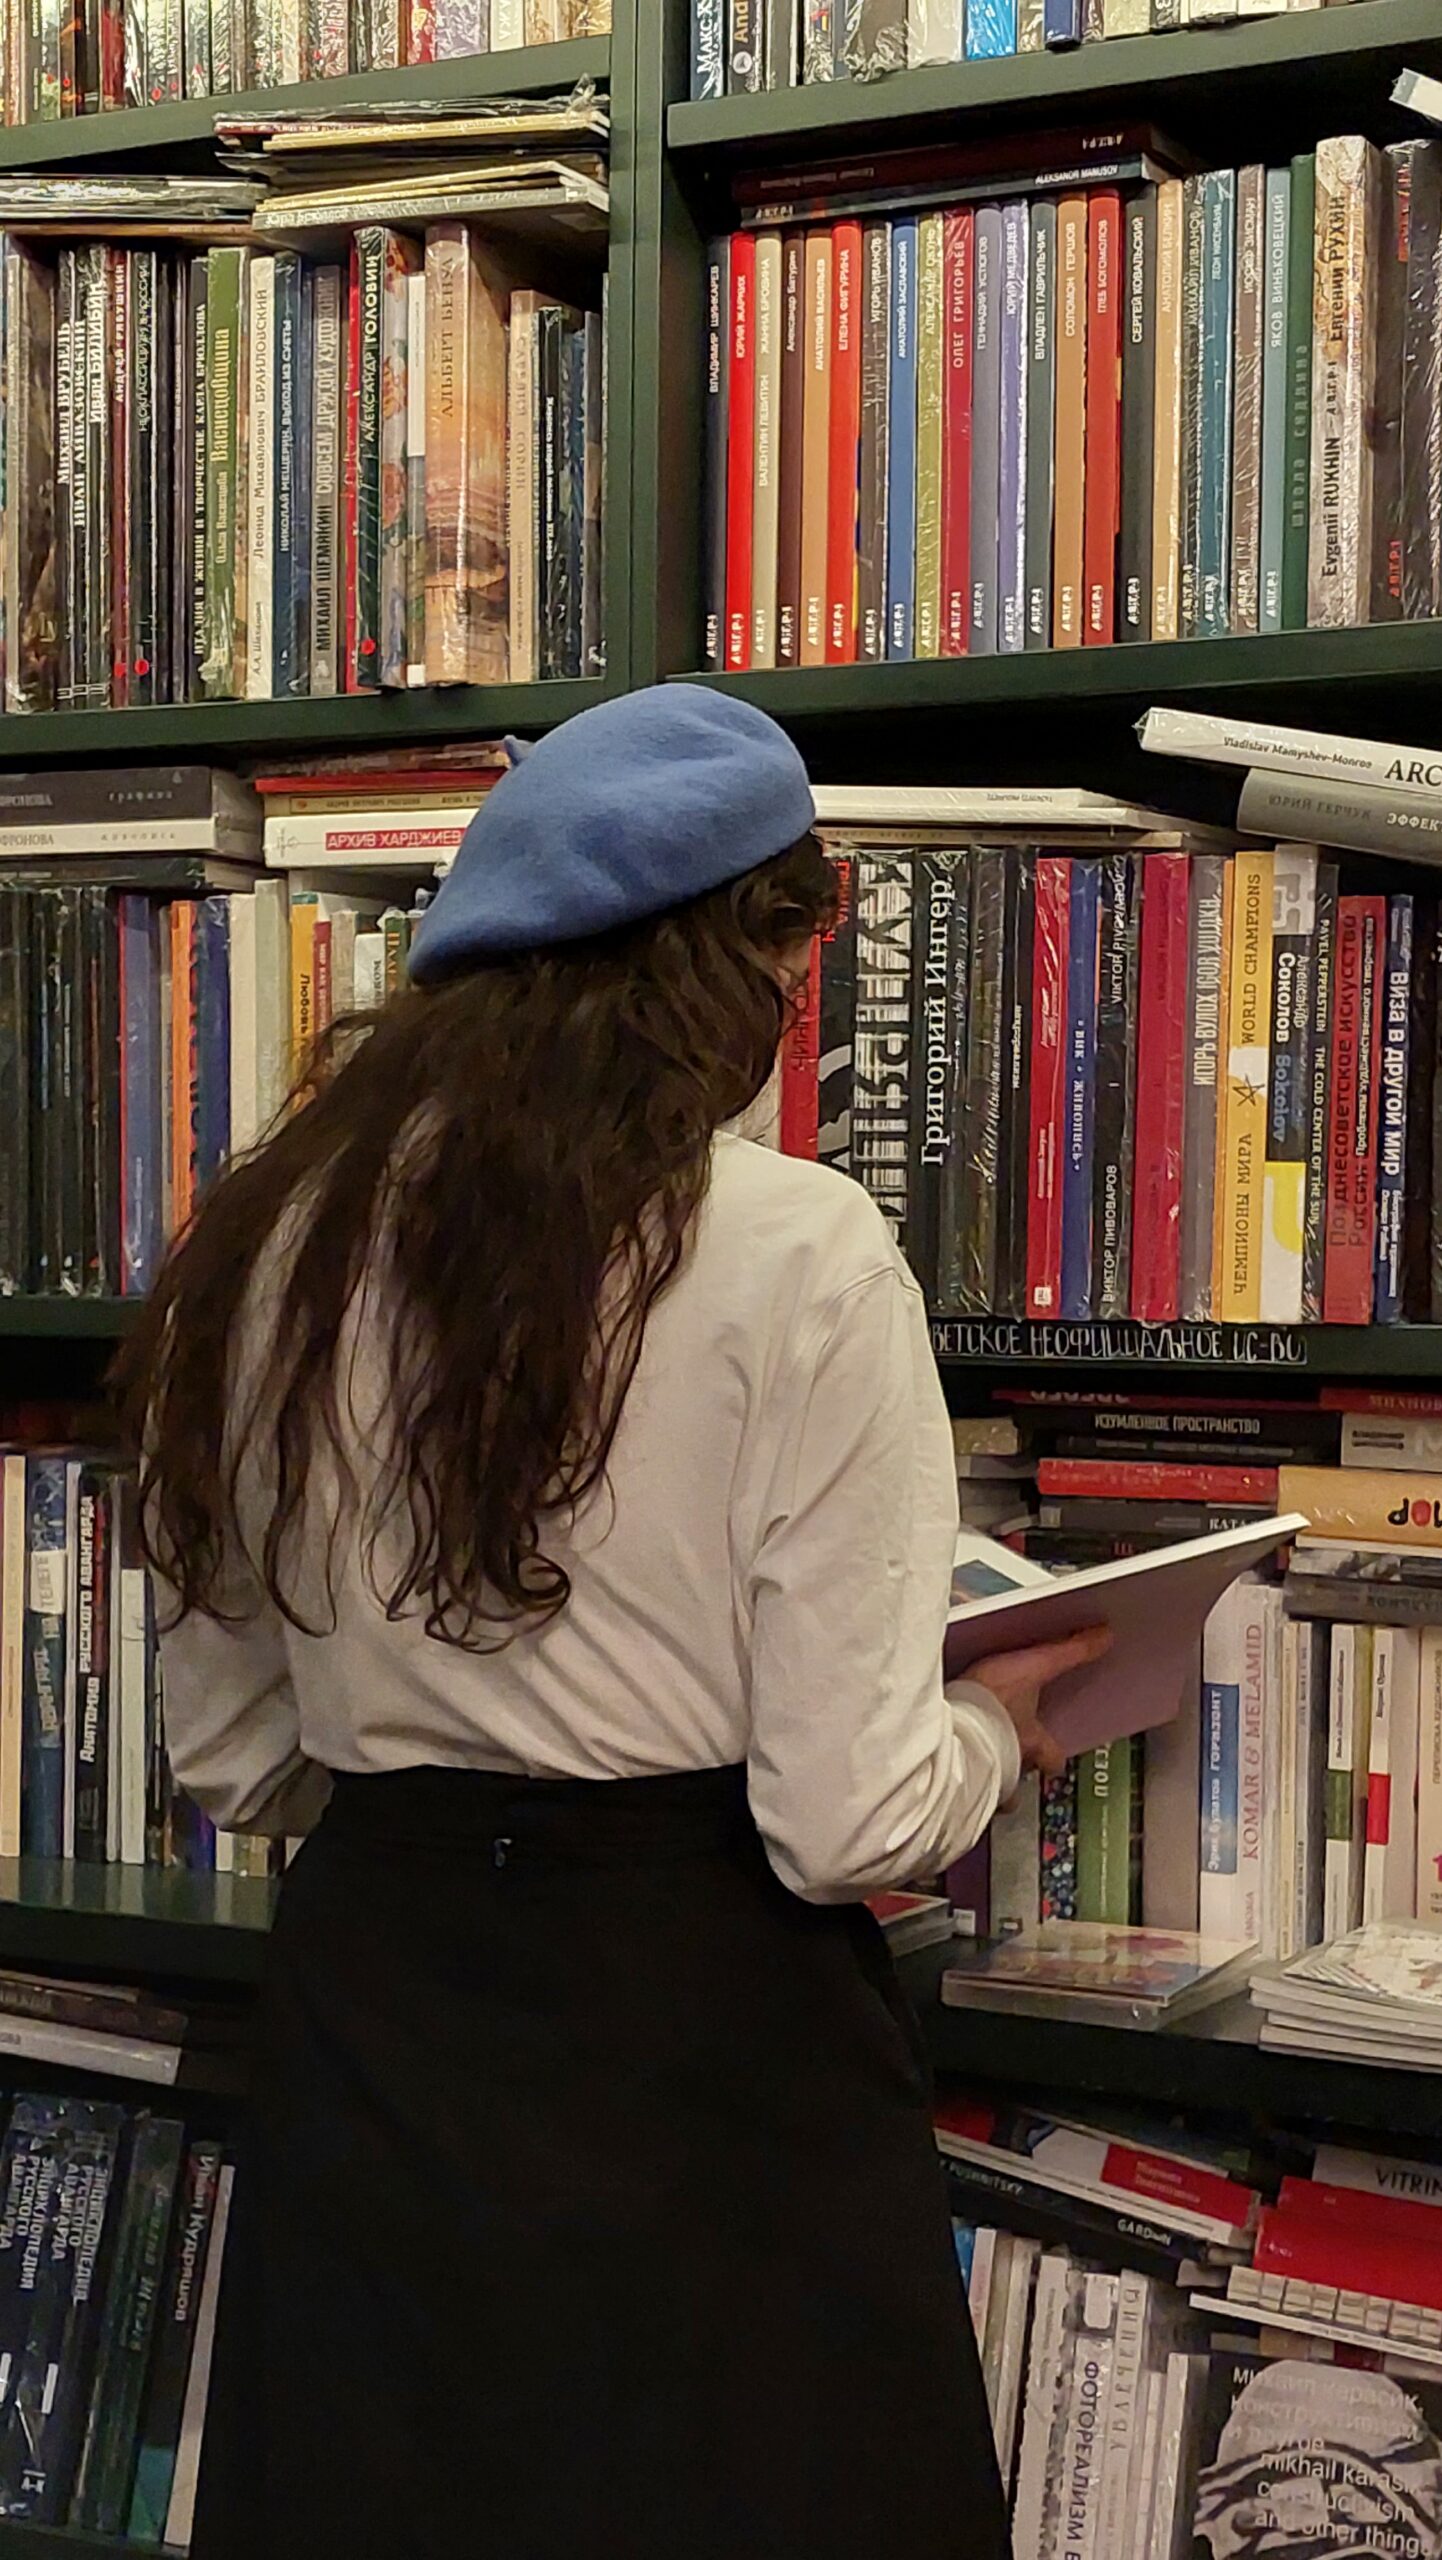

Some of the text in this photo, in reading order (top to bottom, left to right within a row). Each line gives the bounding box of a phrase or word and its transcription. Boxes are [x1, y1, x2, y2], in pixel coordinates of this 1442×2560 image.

[1006, 222, 1017, 316] ЮРИЙ МЕДВЕДЕВ
[1097, 219, 1108, 314] ГЛЕБ БОГОМОЛОВ
[1161, 203, 1174, 312] АНАТОЛИЙ БЕЛКИН
[1271, 193, 1286, 348] ЯКОВ ВИНЬКОВЕЦКИЙ
[1327, 196, 1345, 262] РУХИН
[786, 295, 798, 352] Александр
[815, 258, 826, 371] АНАТОЛИЙ ВАСИЛЬЕВ
[838, 249, 850, 351] ЕЛЕНА ФИГУРИНА
[871, 285, 882, 323] ИГОРЬ
[897, 240, 908, 359] АНАТОЛИЙ ЗАСЛАВСКИЙ
[926, 268, 937, 335] АЛЕКСАНДР
[953, 240, 965, 369] ОЛЕГ ГРИГОРЬЕВ
[976, 291, 987, 350] ГЕННАДИЙ
[1034, 229, 1047, 360] ВЛАДЛЕН ГАВРИЛЬЧИК
[1065, 222, 1076, 337] СОЛОМОН ГЕРШОВ
[1131, 216, 1144, 343] СЕРГЕЙ КОВАЛЬСКИЙ
[1329, 267, 1346, 342] Евгений
[196, 303, 206, 377] БРЮЛЛОВА
[282, 320, 292, 362] СУЕТЫ
[361, 256, 379, 443] АЛЕКСАНДР ГОЛОВИН
[440, 328, 454, 418] АЛЬБЕРТ
[709, 332, 720, 393] ВЛАДИМИР
[735, 323, 746, 358] ЮРИЙ
[760, 312, 771, 354] ЖАННА
[57, 321, 72, 485] Михаил ВРУБЕЛЬ
[74, 319, 87, 527] ИВАН АЙВАЗОВСКИЙ
[89, 377, 105, 424] Иван
[195, 382, 206, 424] КАРЛА
[210, 328, 231, 462] Васнецовщина
[281, 381, 292, 425] ВЫХОД
[195, 429, 206, 513] ТВОРЧЕСТВЕ
[253, 409, 267, 498] Михайлович
[758, 427, 769, 487] ВАЛЕНТИН
[1323, 436, 1341, 507] RUKHIN
[253, 505, 266, 559] Леонид
[280, 493, 291, 552] НИКОЛАЙ
[315, 367, 336, 651] МИХАИЛ ШЕМЯКИН ДРУГОЙ
[1321, 513, 1341, 577] Evgenii
[194, 599, 205, 655] ИТАЛИЯ
[1223, 737, 1269, 753] Vladislav
[1272, 743, 1373, 770] Mamyshev-Monroe
[327, 833, 377, 848] АРХИВ
[1268, 794, 1312, 811] ЮРИЙ
[1111, 954, 1124, 1003] VIKTOR
[1197, 956, 1219, 989] IGOR
[1242, 874, 1260, 1044] WORLD CHAMPIONS
[1276, 952, 1296, 1043] Соколов
[1293, 954, 1310, 1028] Александр
[1339, 915, 1358, 1033] искусство
[299, 973, 311, 1035] Любовь
[920, 876, 956, 1166] Григорий Ингер
[1193, 992, 1218, 1086] ИГОРЬ ВУЛОХ
[1273, 1054, 1292, 1142] Sokolov
[1308, 919, 1330, 1225] PAVEL PEPPERSTEIN THE COLD CENTER OF THE SUN
[1379, 971, 1410, 1176] Виза в другой мир
[1102, 1165, 1118, 1303] ВИКТОР ПИВОВАРОВ
[1233, 1133, 1252, 1295] ЧЕМПИОНЫ МИРА
[933, 1323, 1021, 1355] ВЕТСКОЕ
[1030, 1325, 1223, 1359] НЕОФИЦИАЛЬНОЕ
[1172, 1415, 1261, 1435] ПРОСТРАНСТВО
[78, 1496, 100, 1763] Анатомия РУССКОГО АВАНГАРДА
[1244, 1624, 1262, 1740] MELAMID
[1242, 1774, 1261, 1861] KOMAR
[15, 2155, 42, 2237] РУССКОГО
[19, 2155, 56, 2289] ЭНЦИКЛОПЕДИЯ
[67, 2164, 94, 2247] РУССКОГО
[75, 2165, 109, 2303] ЭНЦИКЛОПЕДИЯ
[173, 2213, 207, 2322] Кудряшов
[1066, 2361, 1100, 2540] ФОТОРЕАЛИЗМ
